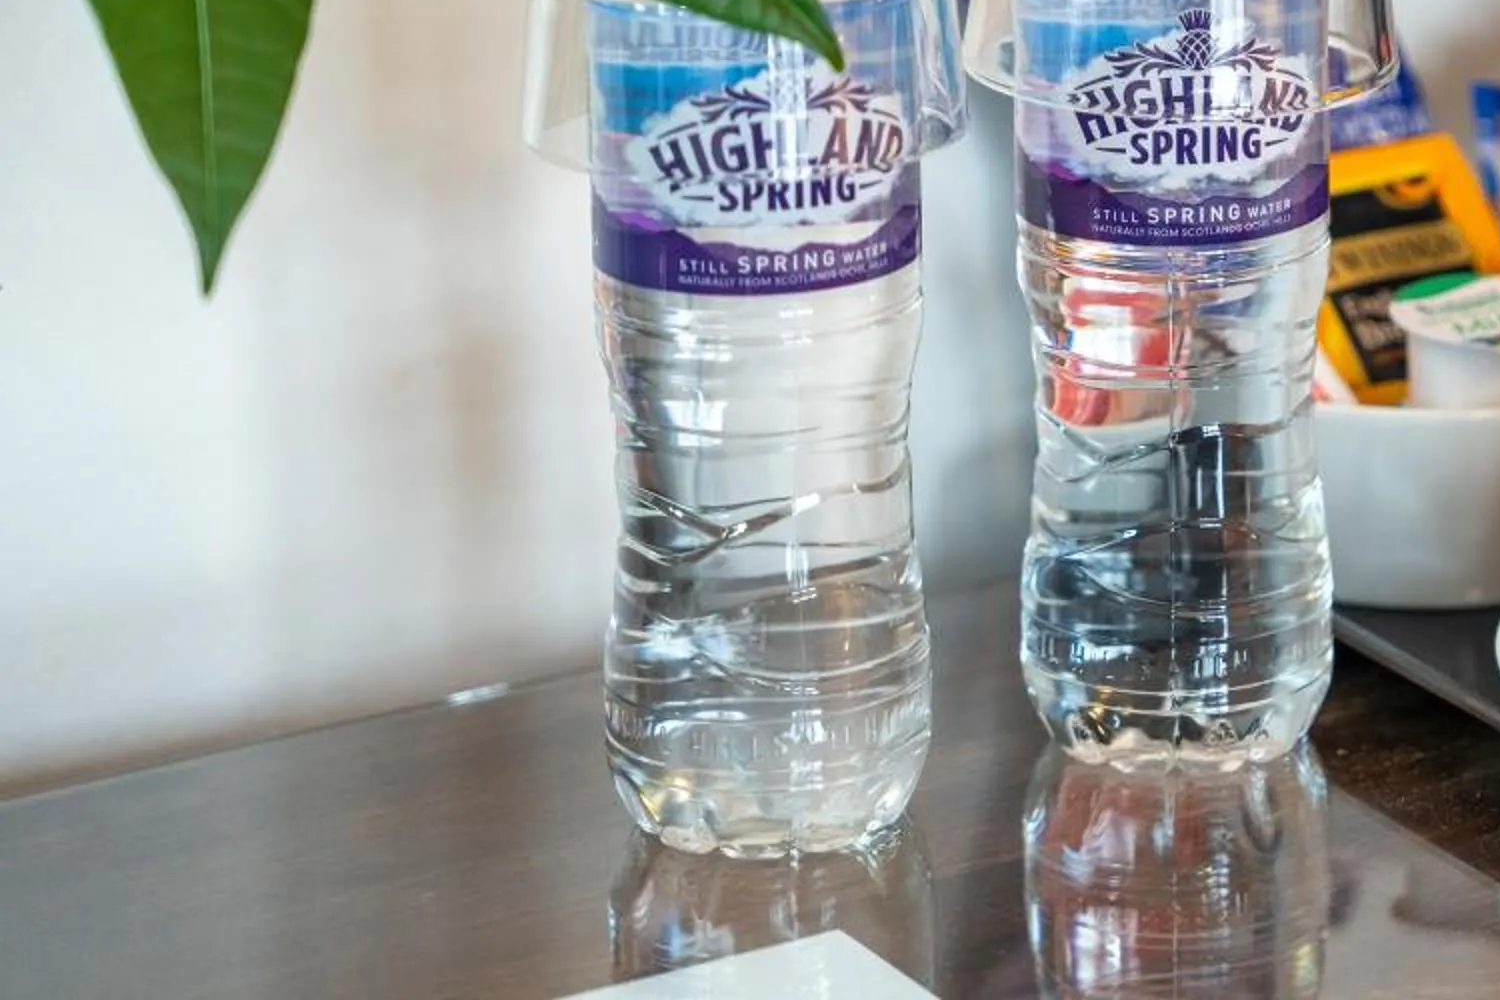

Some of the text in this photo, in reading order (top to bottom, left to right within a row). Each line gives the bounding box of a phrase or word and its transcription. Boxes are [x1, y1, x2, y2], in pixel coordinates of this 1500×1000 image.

[1130, 126, 1262, 165] SPRING
[718, 176, 856, 212] SPRING
[1093, 207, 1140, 224] STILL
[1147, 203, 1240, 226] SPRING
[1247, 198, 1291, 219] WATER
[1147, 226, 1179, 238] FROM
[680, 241, 887, 275] STILL SPRING WATER
[738, 277, 772, 289] FROM
